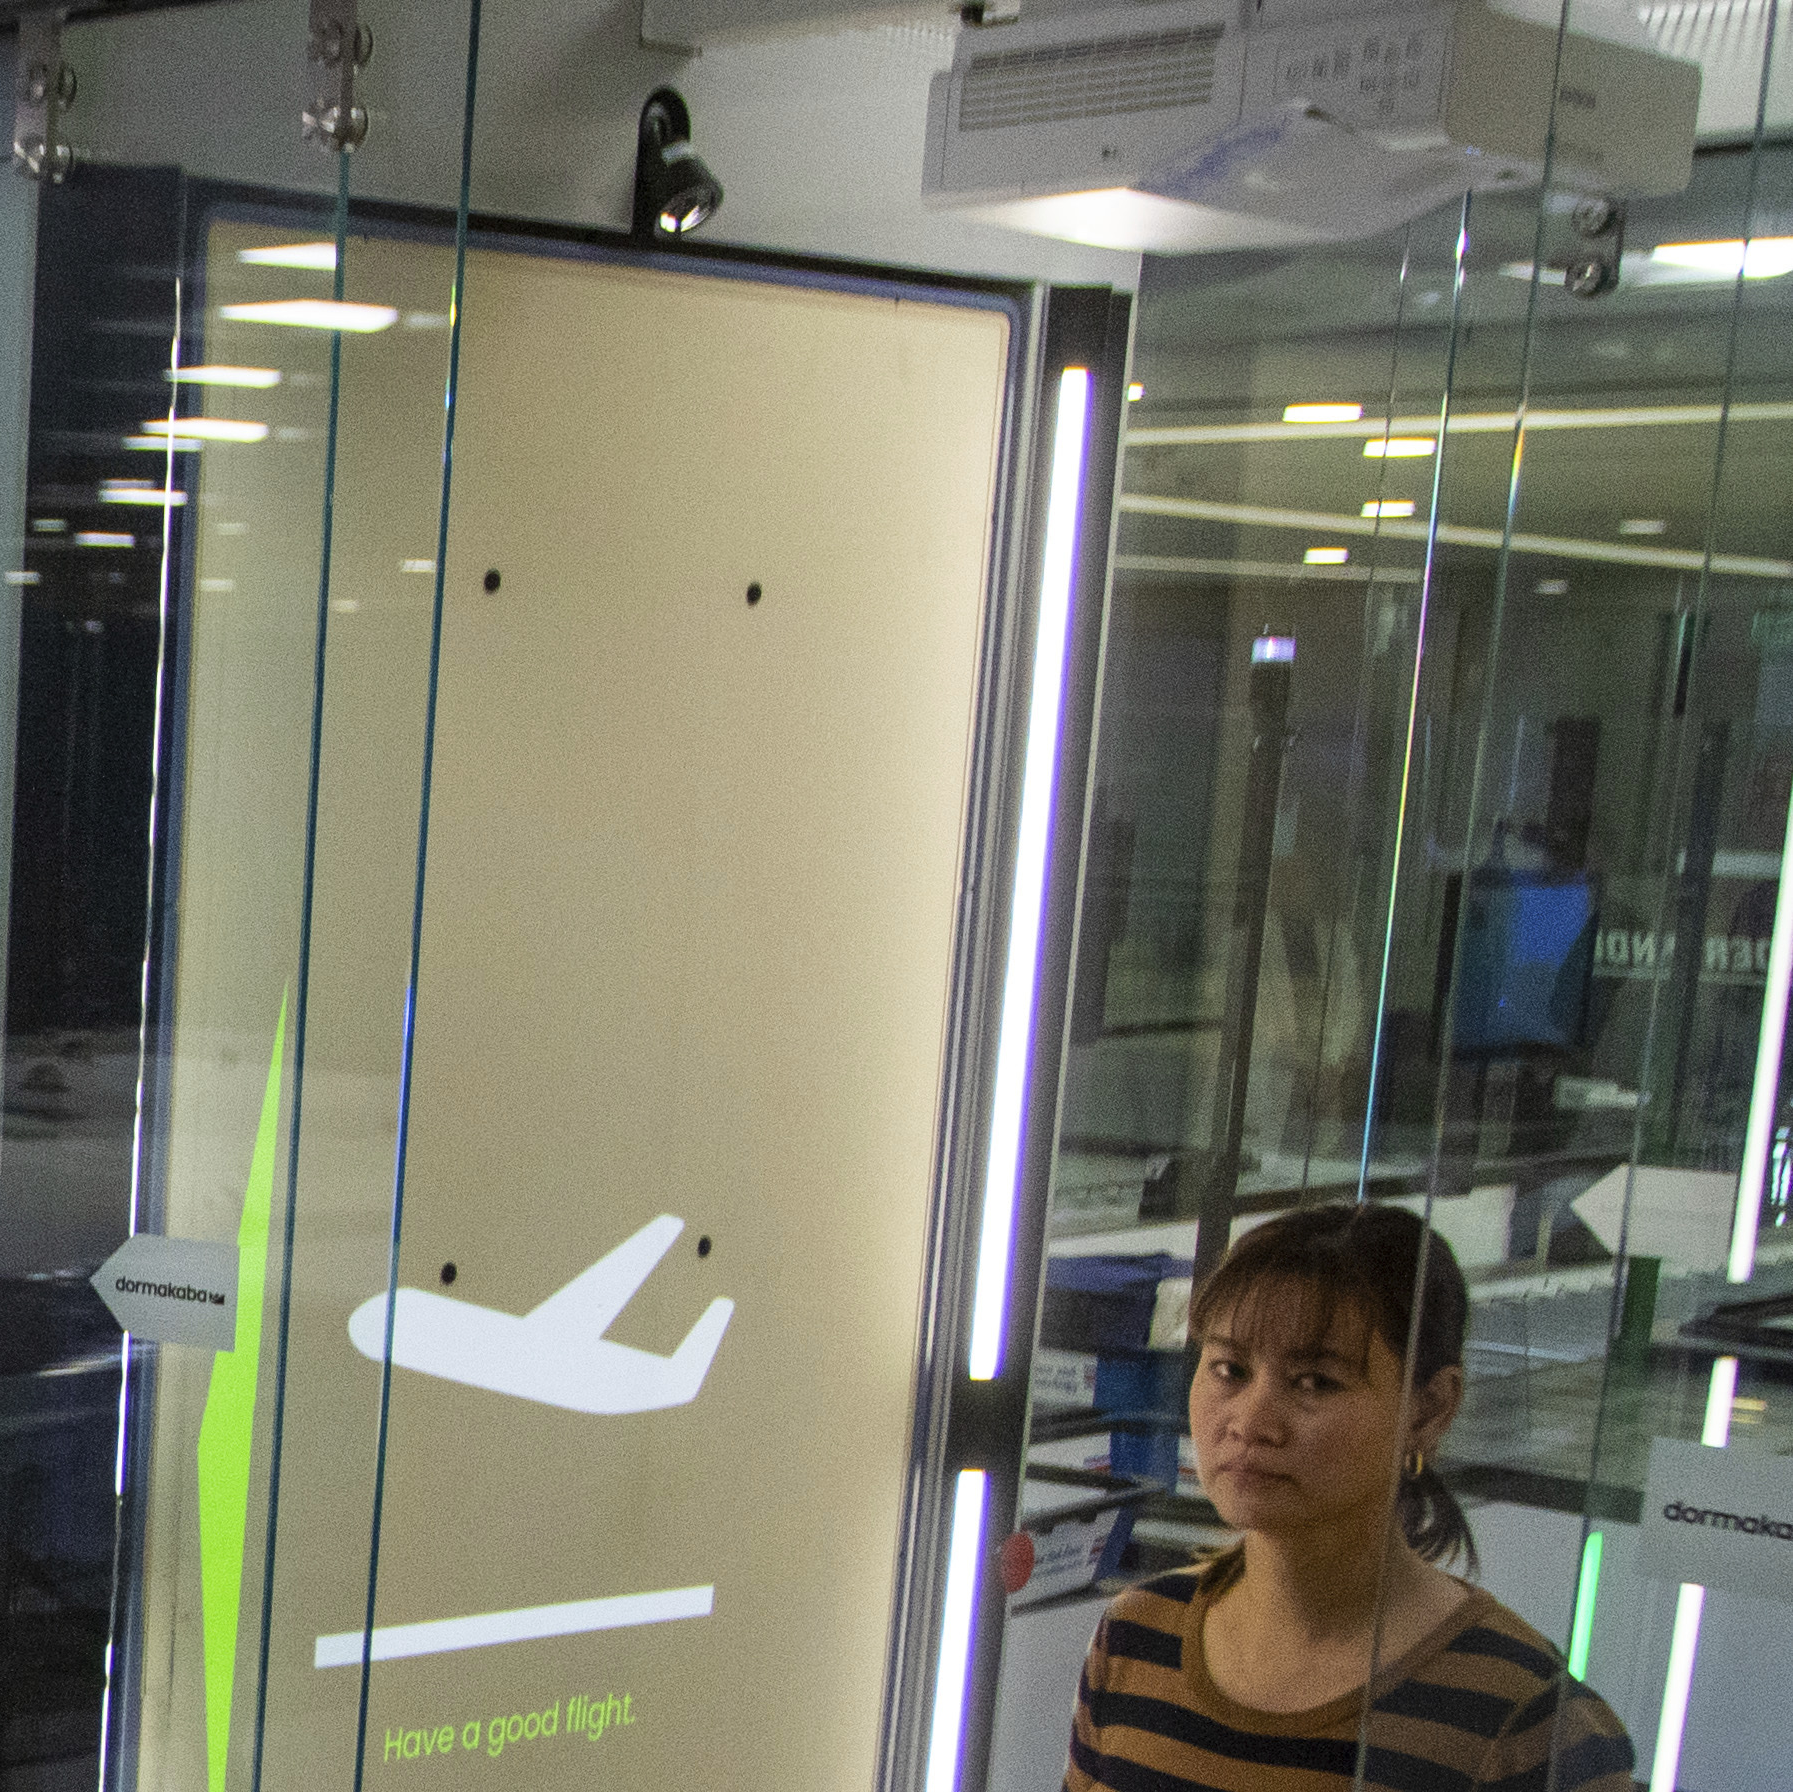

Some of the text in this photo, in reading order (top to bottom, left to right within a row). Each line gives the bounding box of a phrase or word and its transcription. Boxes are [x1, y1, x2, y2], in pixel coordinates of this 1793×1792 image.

[115, 1276, 207, 1302] dormakaba
[384, 1692, 636, 1762] Have a good flight.
